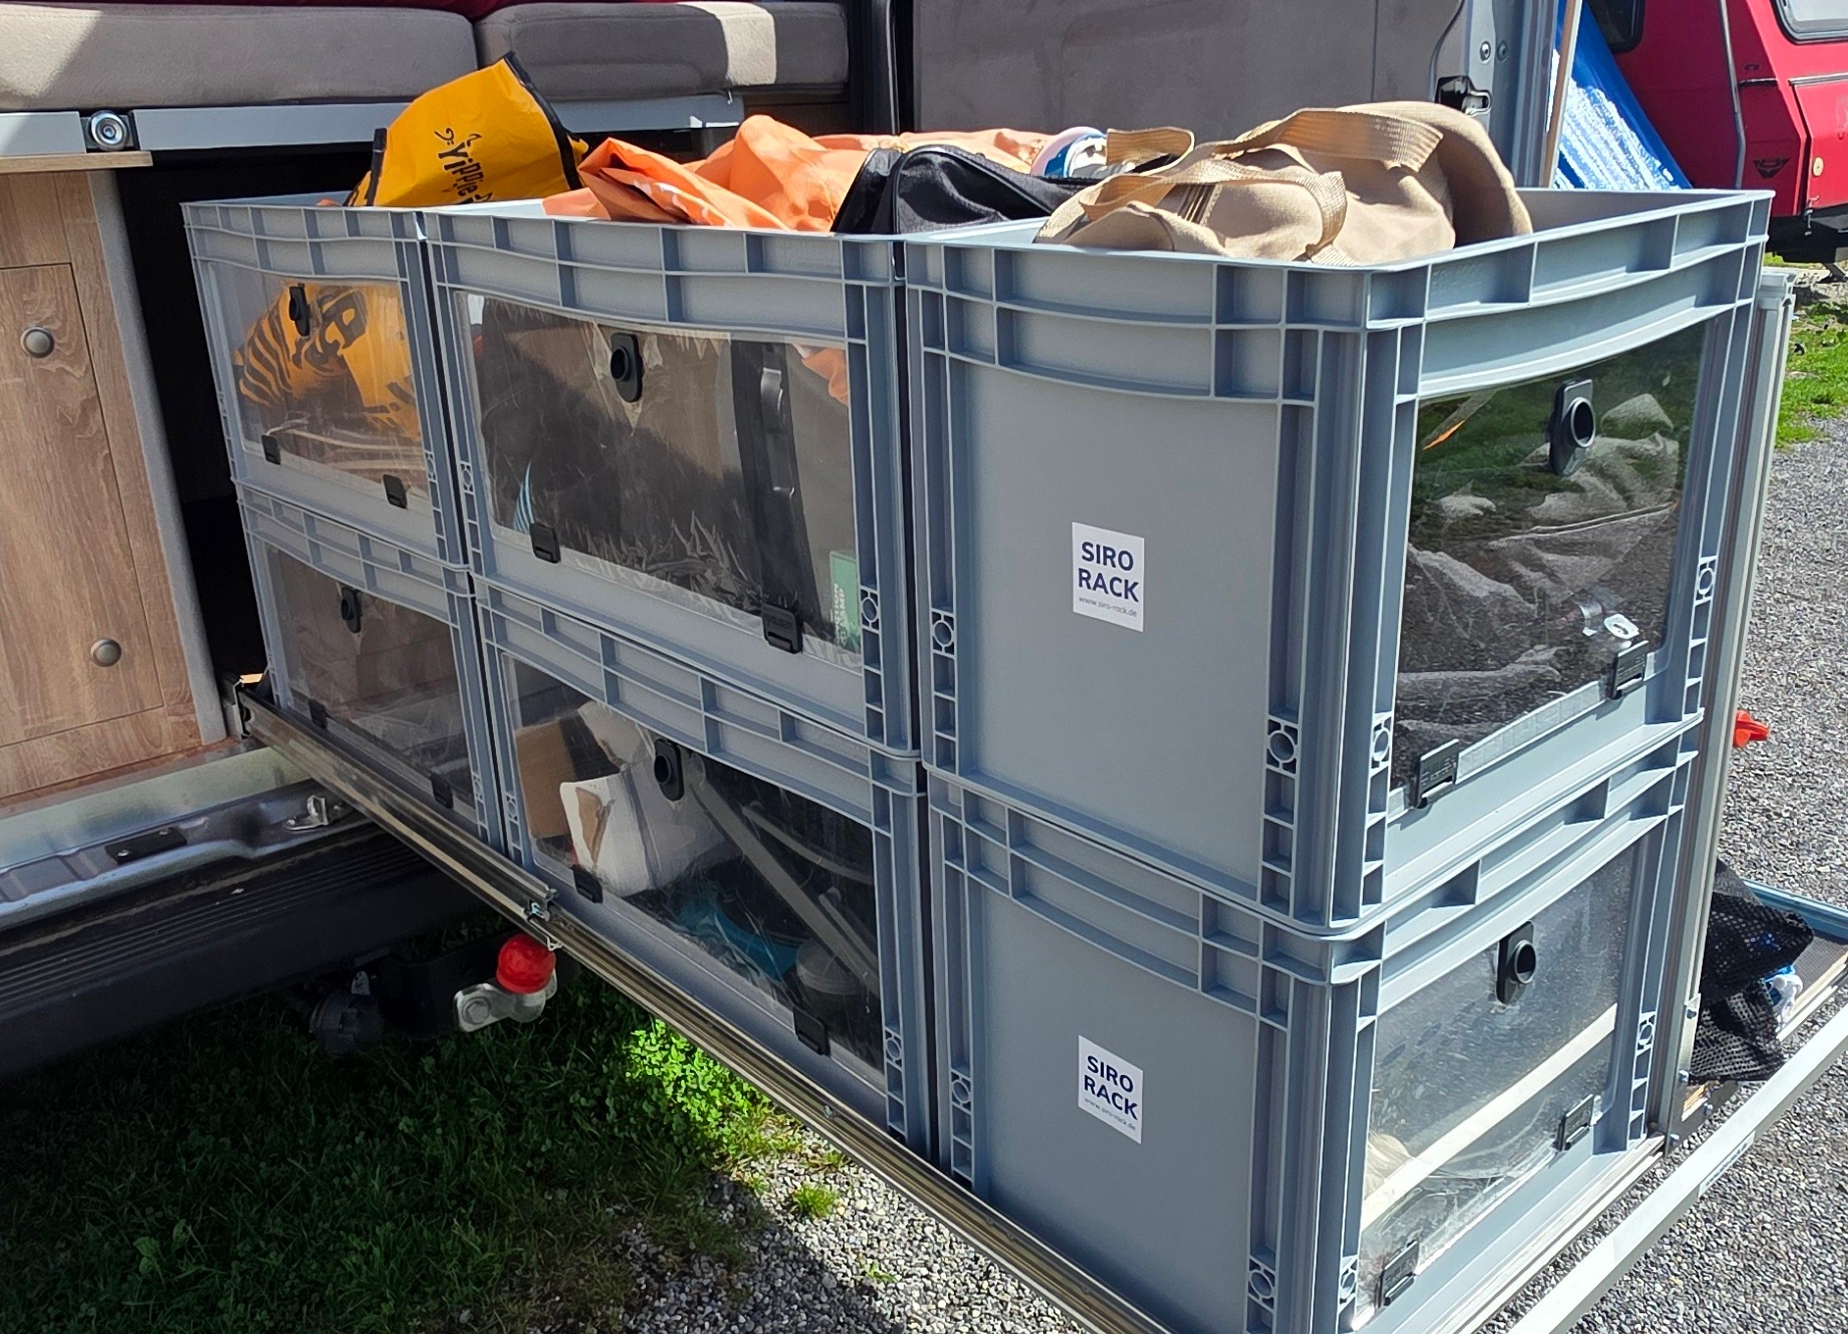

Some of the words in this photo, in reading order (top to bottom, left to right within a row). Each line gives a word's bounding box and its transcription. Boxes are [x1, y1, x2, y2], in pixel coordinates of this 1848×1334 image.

[1081, 541, 1134, 572] SIRO
[1077, 567, 1139, 603] RACK
[1086, 1055, 1134, 1093] SIRO
[1084, 1074, 1138, 1121] RACK
